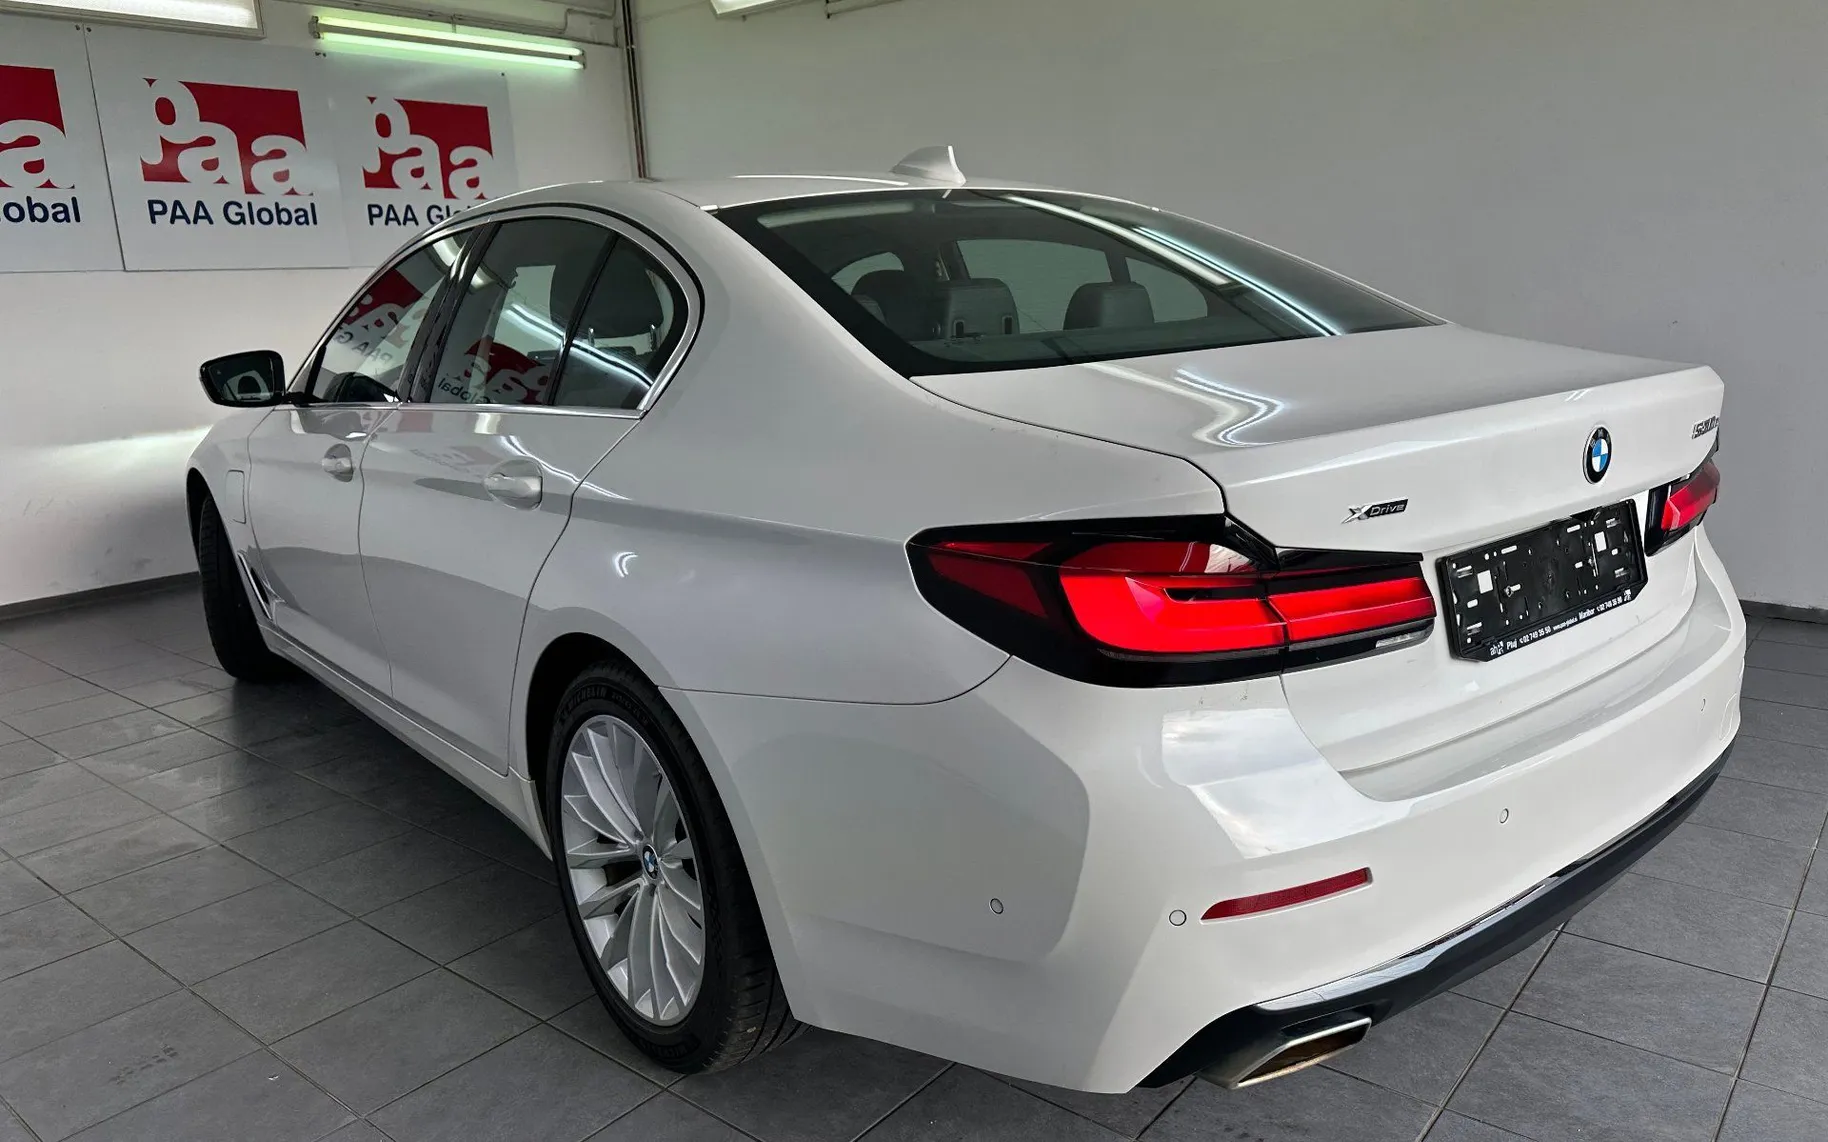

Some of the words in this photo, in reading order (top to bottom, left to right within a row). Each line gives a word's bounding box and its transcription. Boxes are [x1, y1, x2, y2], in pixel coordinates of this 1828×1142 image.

[0, 195, 81, 223] obal
[147, 199, 214, 225] PAA
[223, 200, 318, 226] Global
[367, 203, 419, 226] PAA
